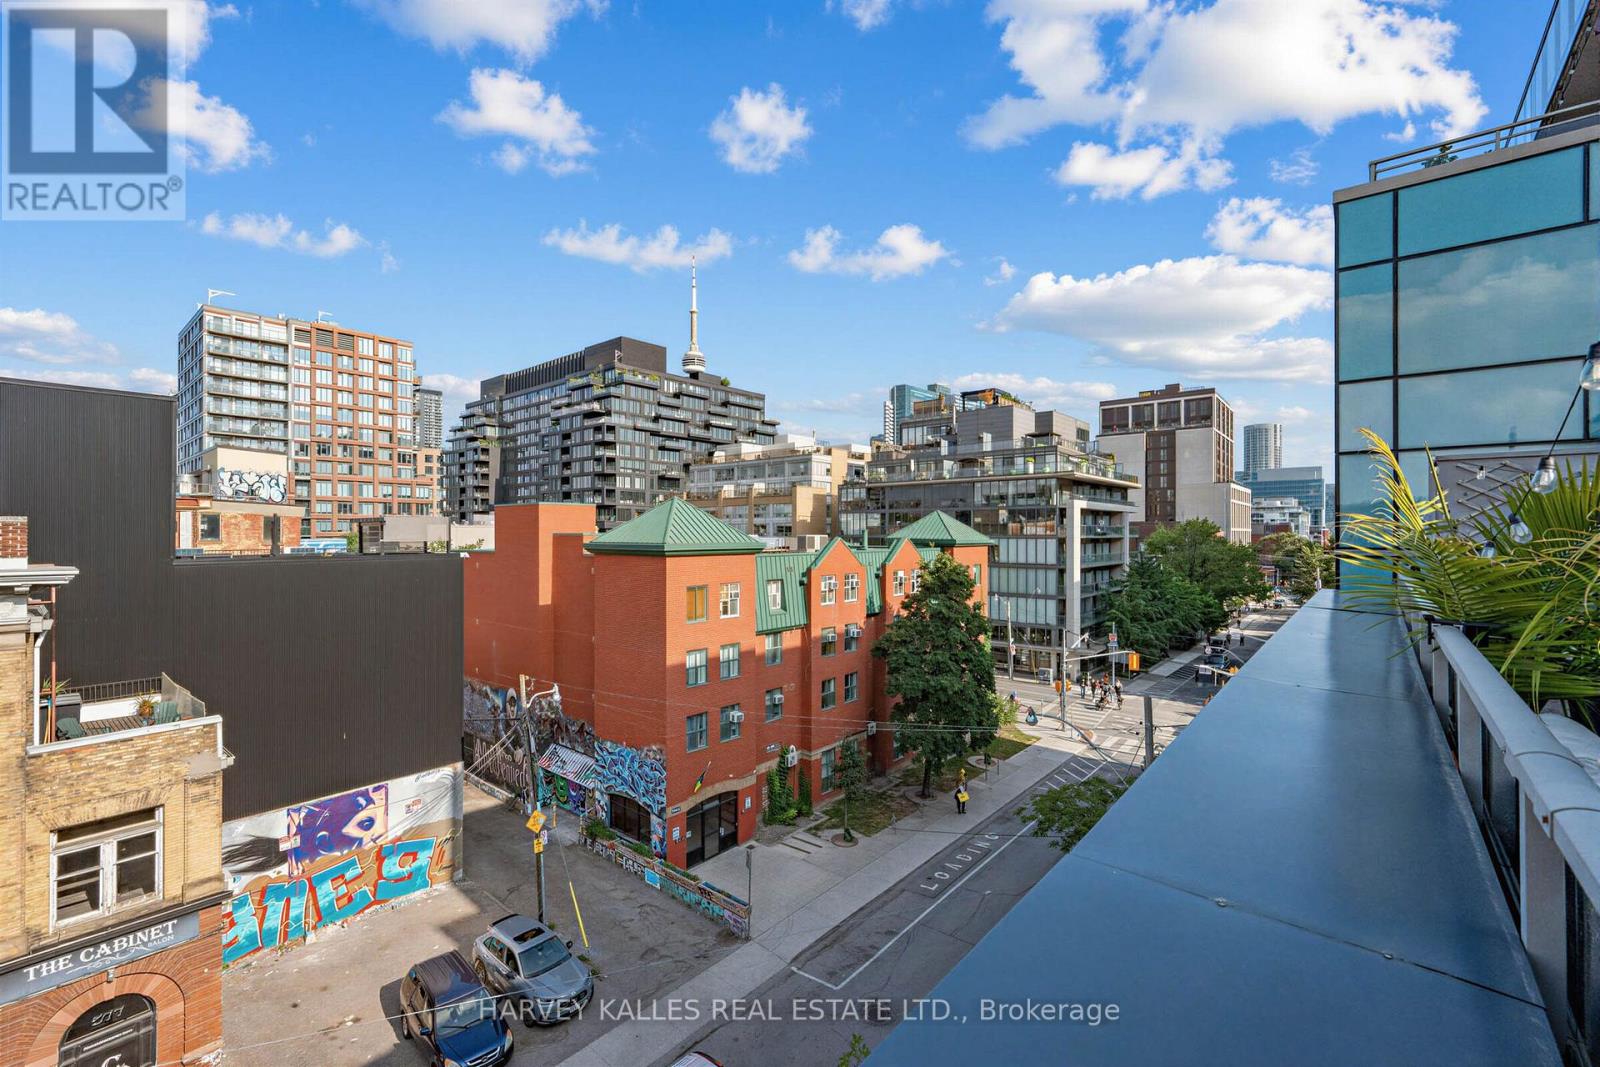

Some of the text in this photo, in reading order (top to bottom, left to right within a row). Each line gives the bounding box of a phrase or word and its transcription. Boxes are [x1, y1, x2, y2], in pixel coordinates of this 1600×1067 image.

[920, 832, 999, 891] LOADING
[23, 920, 178, 982] THE CABINET
[147, 933, 175, 948] SALON
